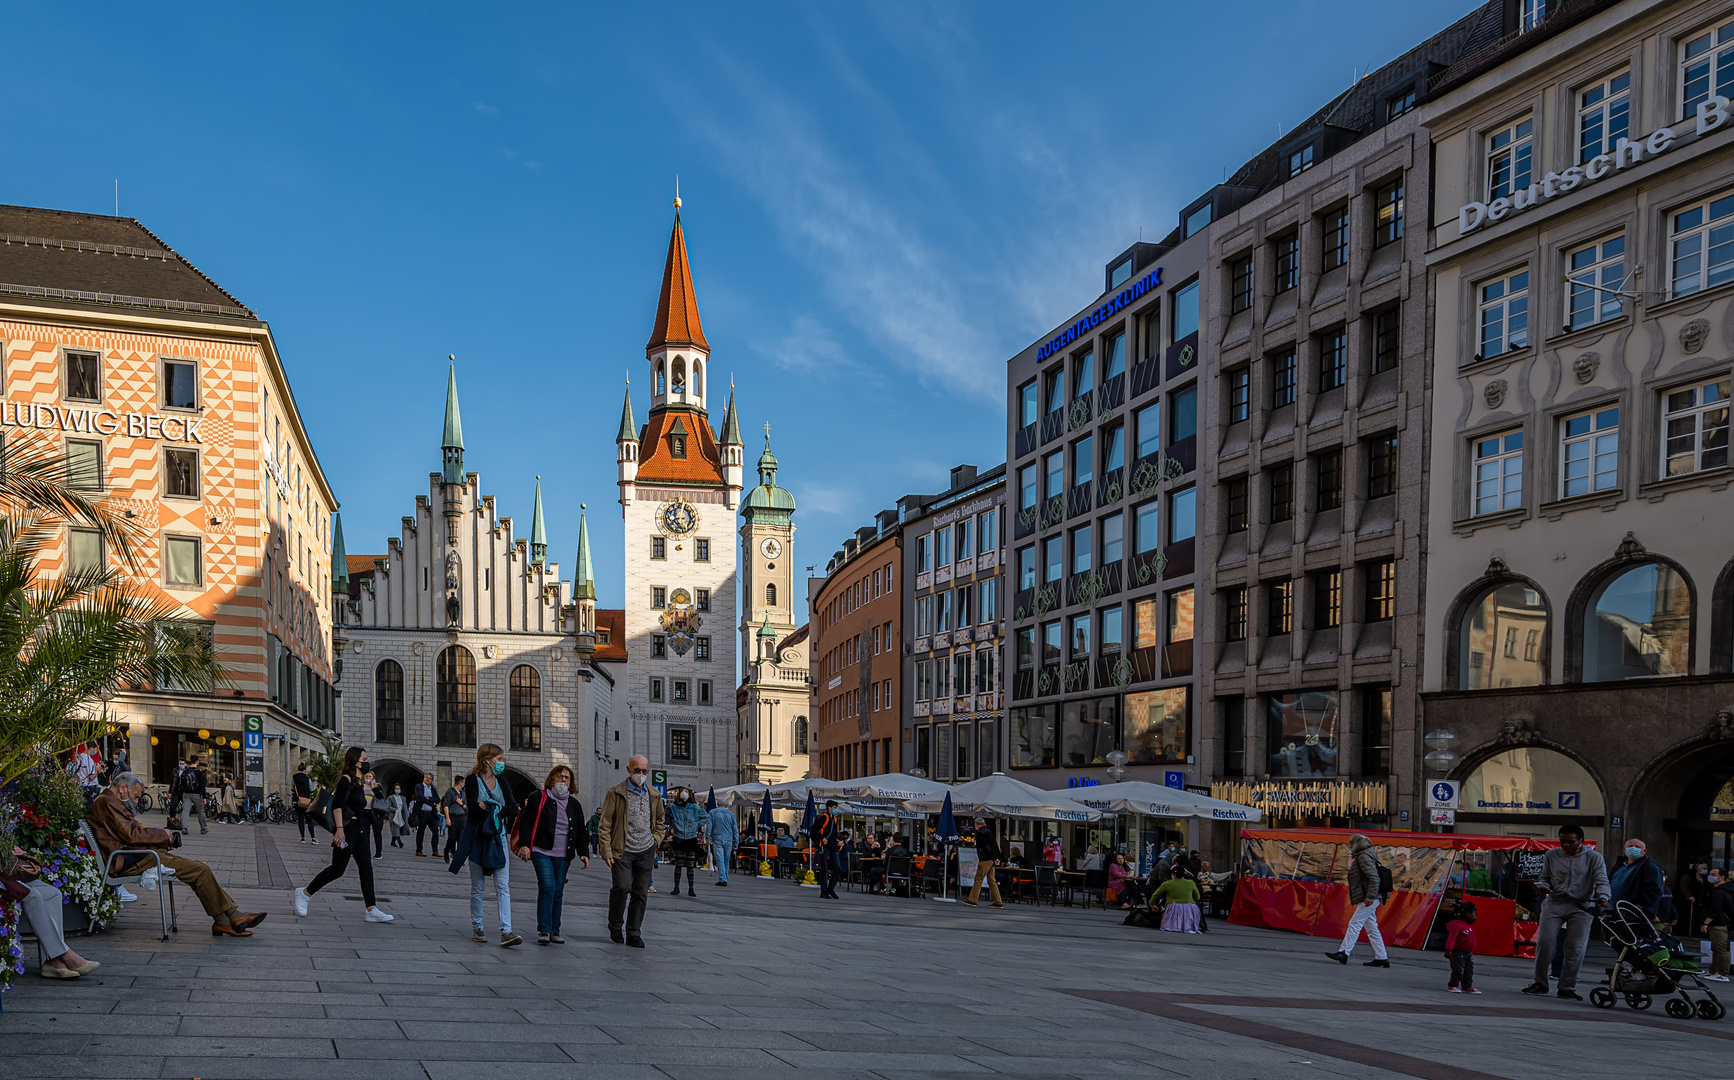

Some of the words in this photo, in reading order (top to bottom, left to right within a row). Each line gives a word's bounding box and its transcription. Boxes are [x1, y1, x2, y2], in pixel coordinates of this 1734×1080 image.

[1459, 127, 1677, 235] Deutsche
[1036, 267, 1163, 364] AUGENTAGESKLINIK
[1, 402, 119, 435] LUDWIG
[128, 412, 203, 443] BECK
[248, 717, 259, 730] S
[248, 734, 259, 747] U
[655, 771, 664, 783] S
[1266, 791, 1330, 803] SWAROVSKI
[1149, 802, 1170, 814] Café
[1212, 808, 1247, 819] Rischart
[1478, 800, 1523, 808] Deutsche
[1526, 801, 1553, 809] Bank
[1004, 804, 1022, 814] Café
[1054, 808, 1090, 820] Rischart
